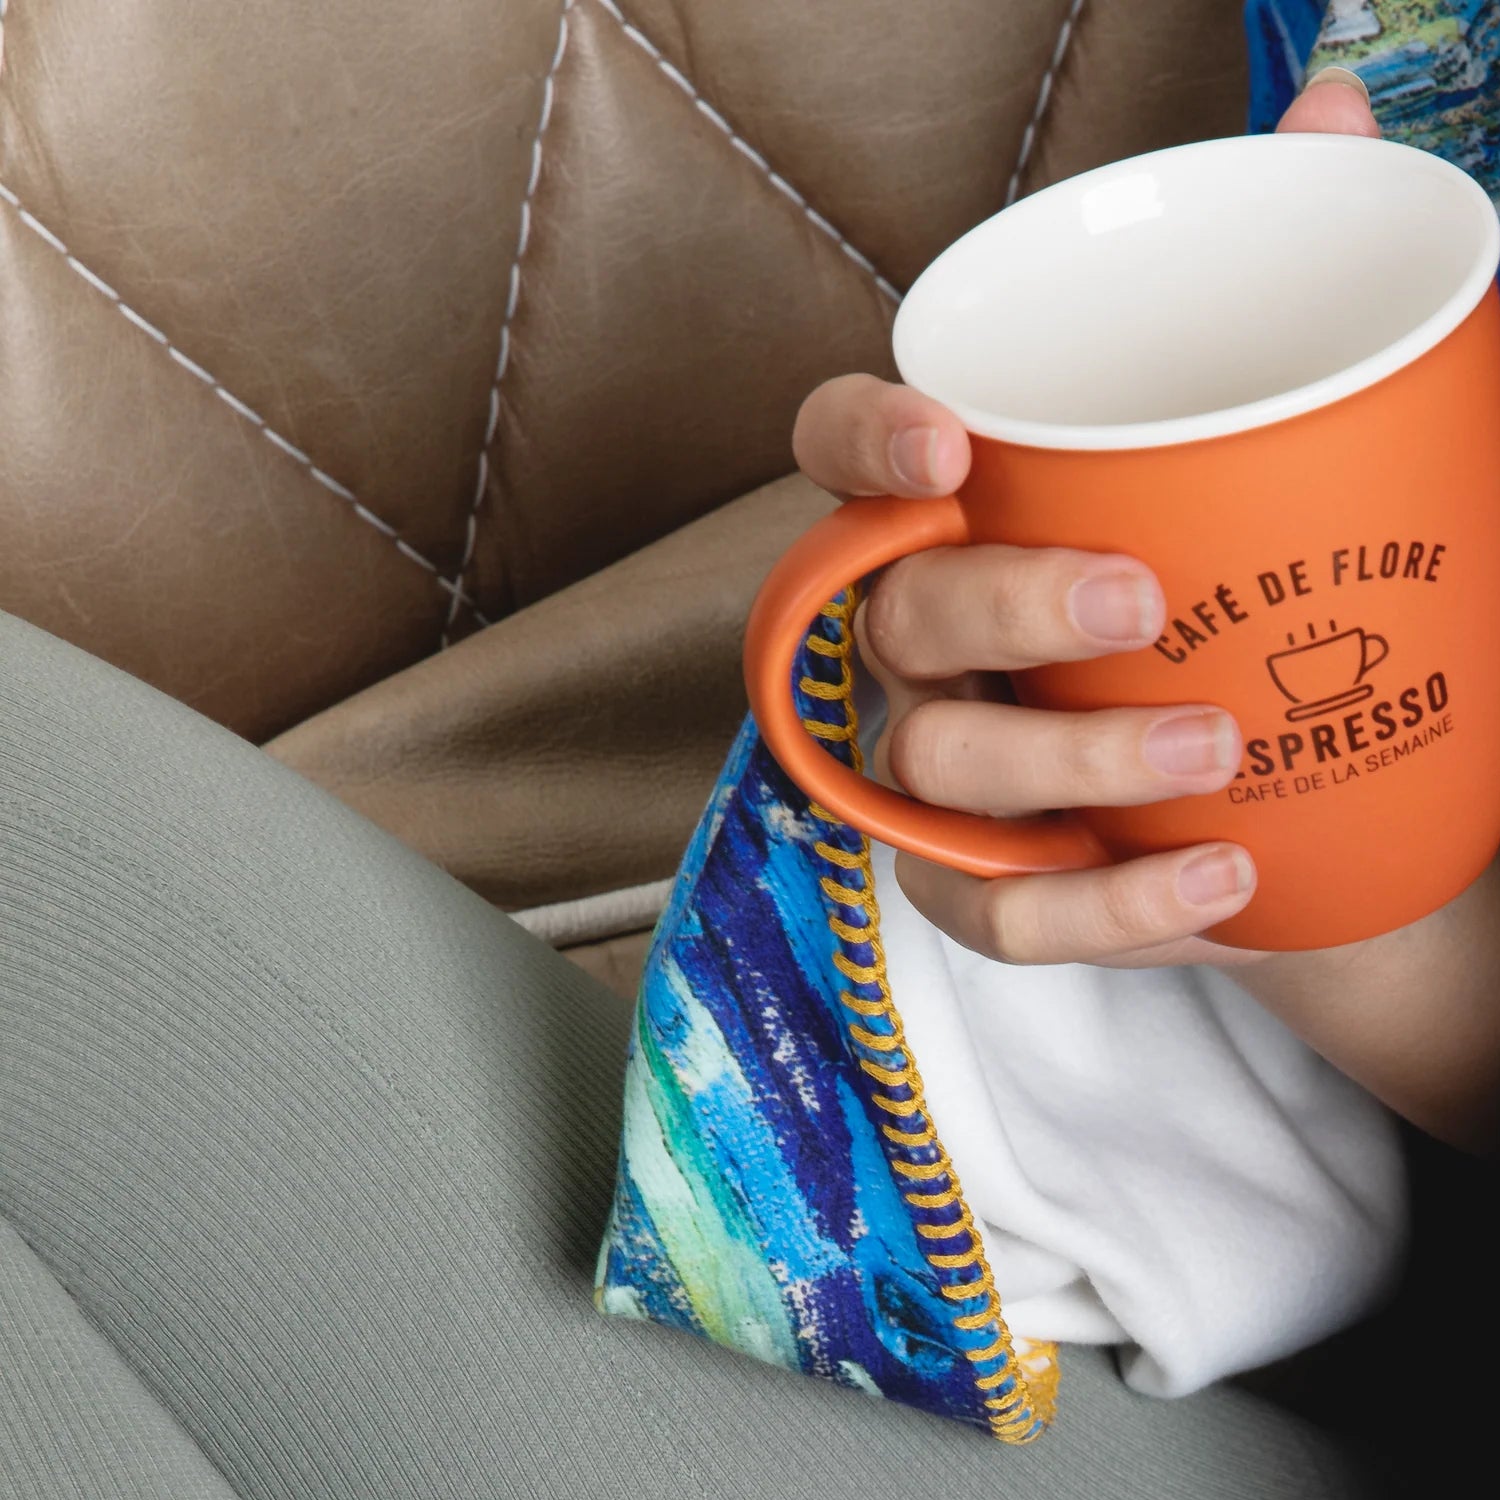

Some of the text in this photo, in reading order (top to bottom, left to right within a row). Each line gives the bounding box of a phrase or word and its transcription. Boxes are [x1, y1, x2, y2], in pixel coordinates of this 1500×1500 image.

[1153, 541, 1447, 664] CAFÉ DE FLORE
[1233, 671, 1449, 780] SPRESSO
[1228, 778, 1288, 805] CAFÉ
[1295, 773, 1326, 795] DE
[1331, 763, 1360, 785] LA
